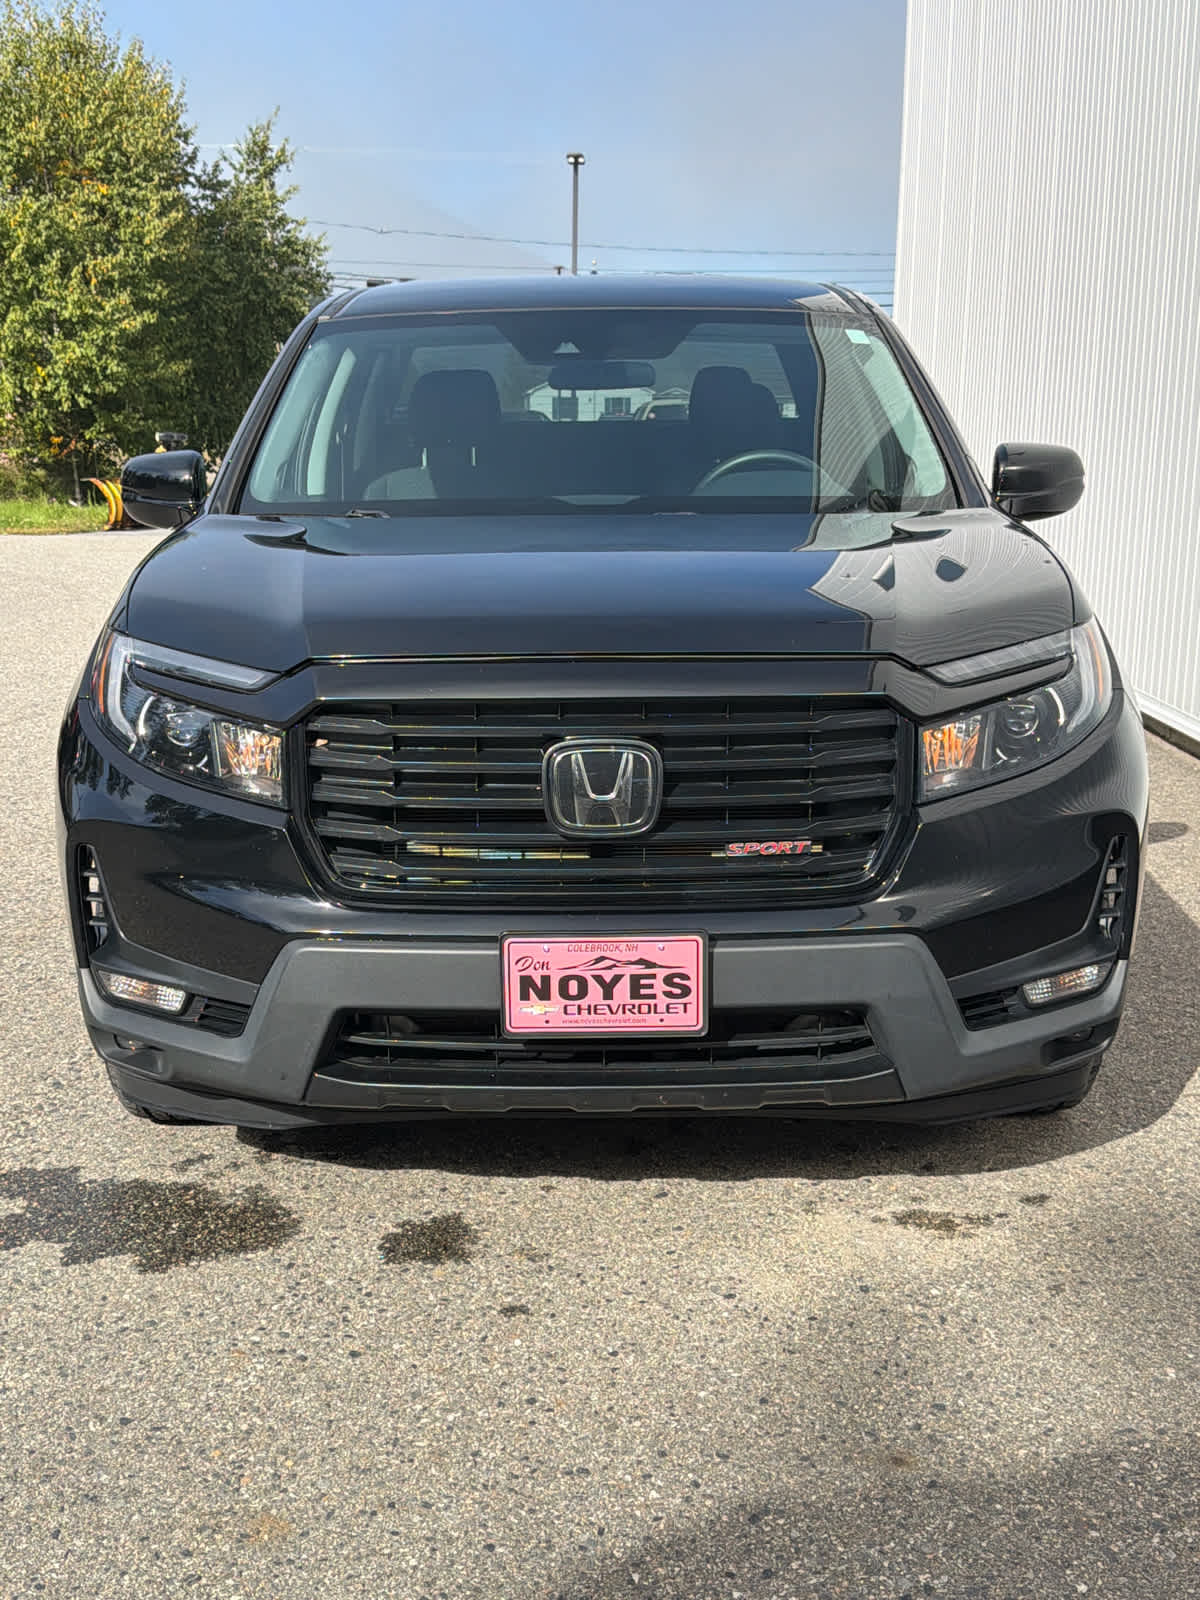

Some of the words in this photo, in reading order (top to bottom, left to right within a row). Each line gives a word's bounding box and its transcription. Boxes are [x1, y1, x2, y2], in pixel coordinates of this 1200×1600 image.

[727, 841, 812, 856] SPORT
[567, 943, 623, 953] COLEBROOK,
[624, 943, 639, 952] NH
[514, 955, 550, 972] Don
[519, 972, 692, 1001] NOYES
[563, 1002, 692, 1016] CHEVROLET
